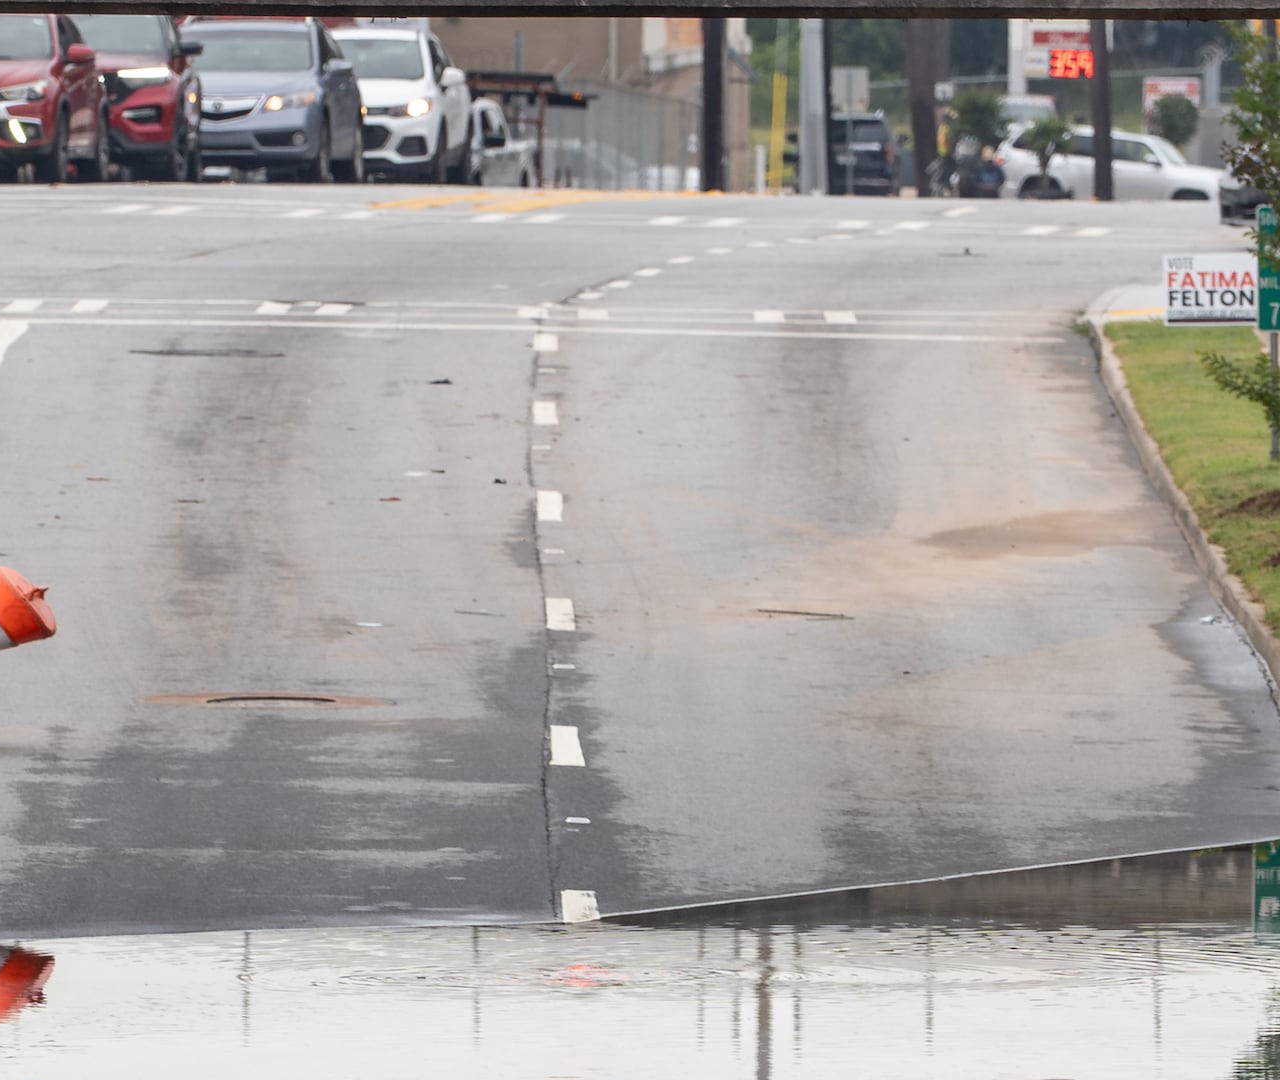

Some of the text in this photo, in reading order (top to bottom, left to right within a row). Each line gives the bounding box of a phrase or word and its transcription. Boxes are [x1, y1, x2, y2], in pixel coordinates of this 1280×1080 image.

[1167, 258, 1193, 270] VOTE
[1167, 271, 1255, 289] FATIMA
[1168, 290, 1255, 307] FELTON
[1268, 302, 1280, 327] 7
